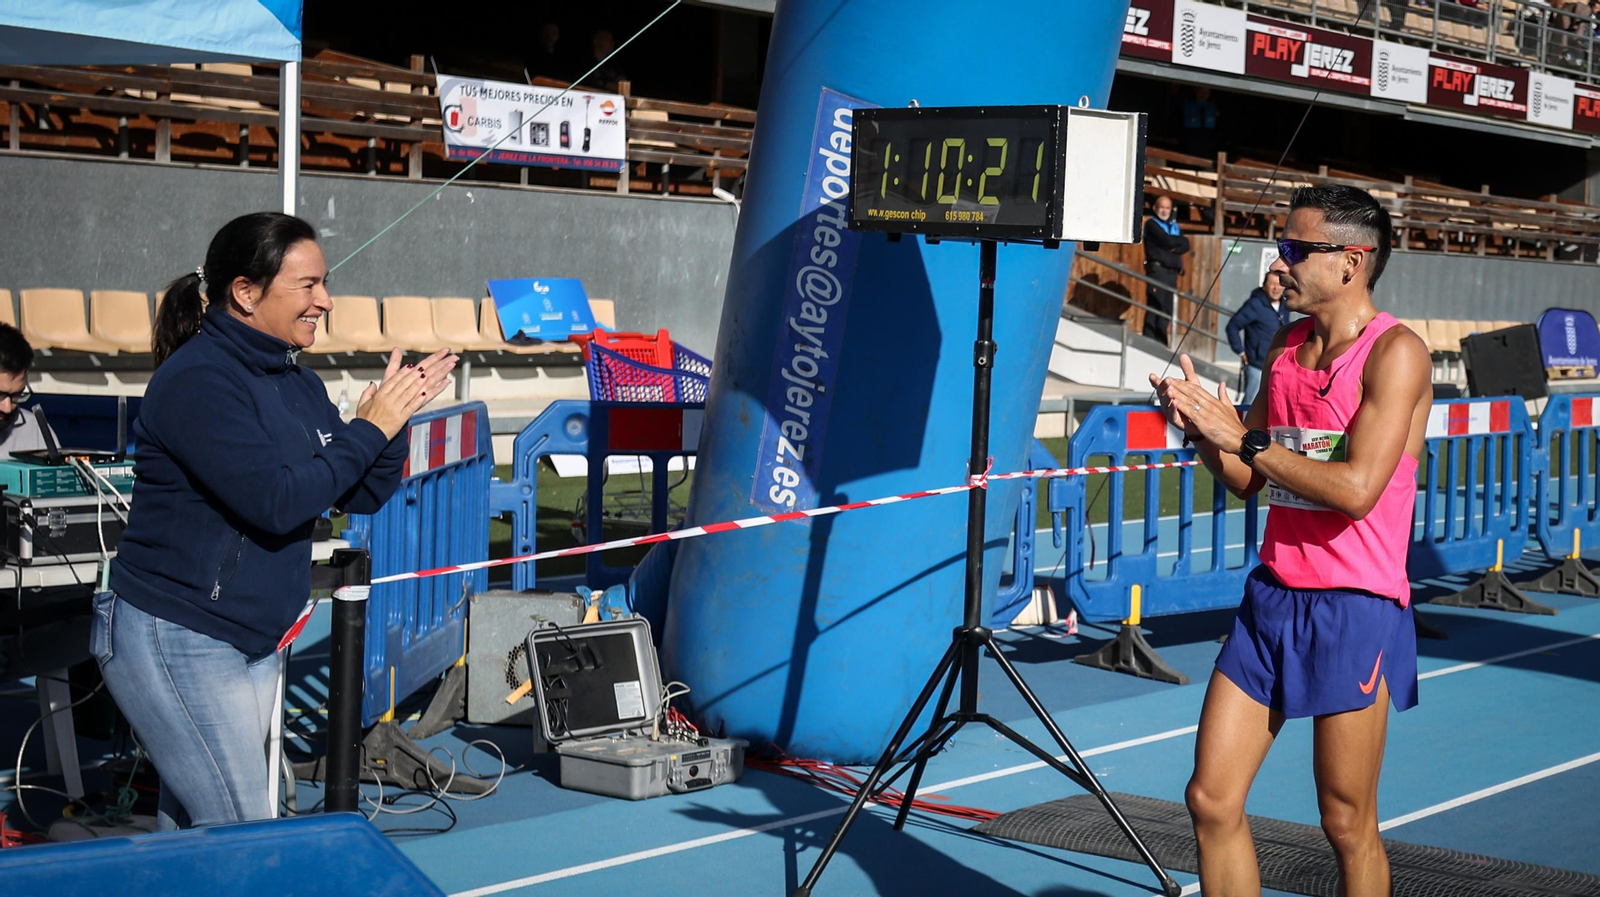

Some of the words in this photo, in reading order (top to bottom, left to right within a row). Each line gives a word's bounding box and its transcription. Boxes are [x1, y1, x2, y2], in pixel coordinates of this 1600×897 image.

[1198, 27, 1239, 43] Ayuntamiento
[1252, 33, 1302, 62] PLAY
[1290, 41, 1355, 78] JEREZ
[1432, 67, 1474, 93] PLAY
[1463, 74, 1516, 107] JEREZ
[460, 84, 478, 98] TUS
[480, 87, 522, 103] MEJORES
[523, 93, 560, 107] PRECIOS
[561, 98, 574, 108] EN
[467, 116, 502, 130] CARBIS
[528, 154, 537, 162] LA
[537, 155, 568, 165] FRONTERA
[910, 209, 927, 222] chip
[944, 210, 957, 221] 615
[958, 211, 971, 221] 980
[971, 211, 984, 222] 784
[1302, 440, 1331, 451] MARATÓN
